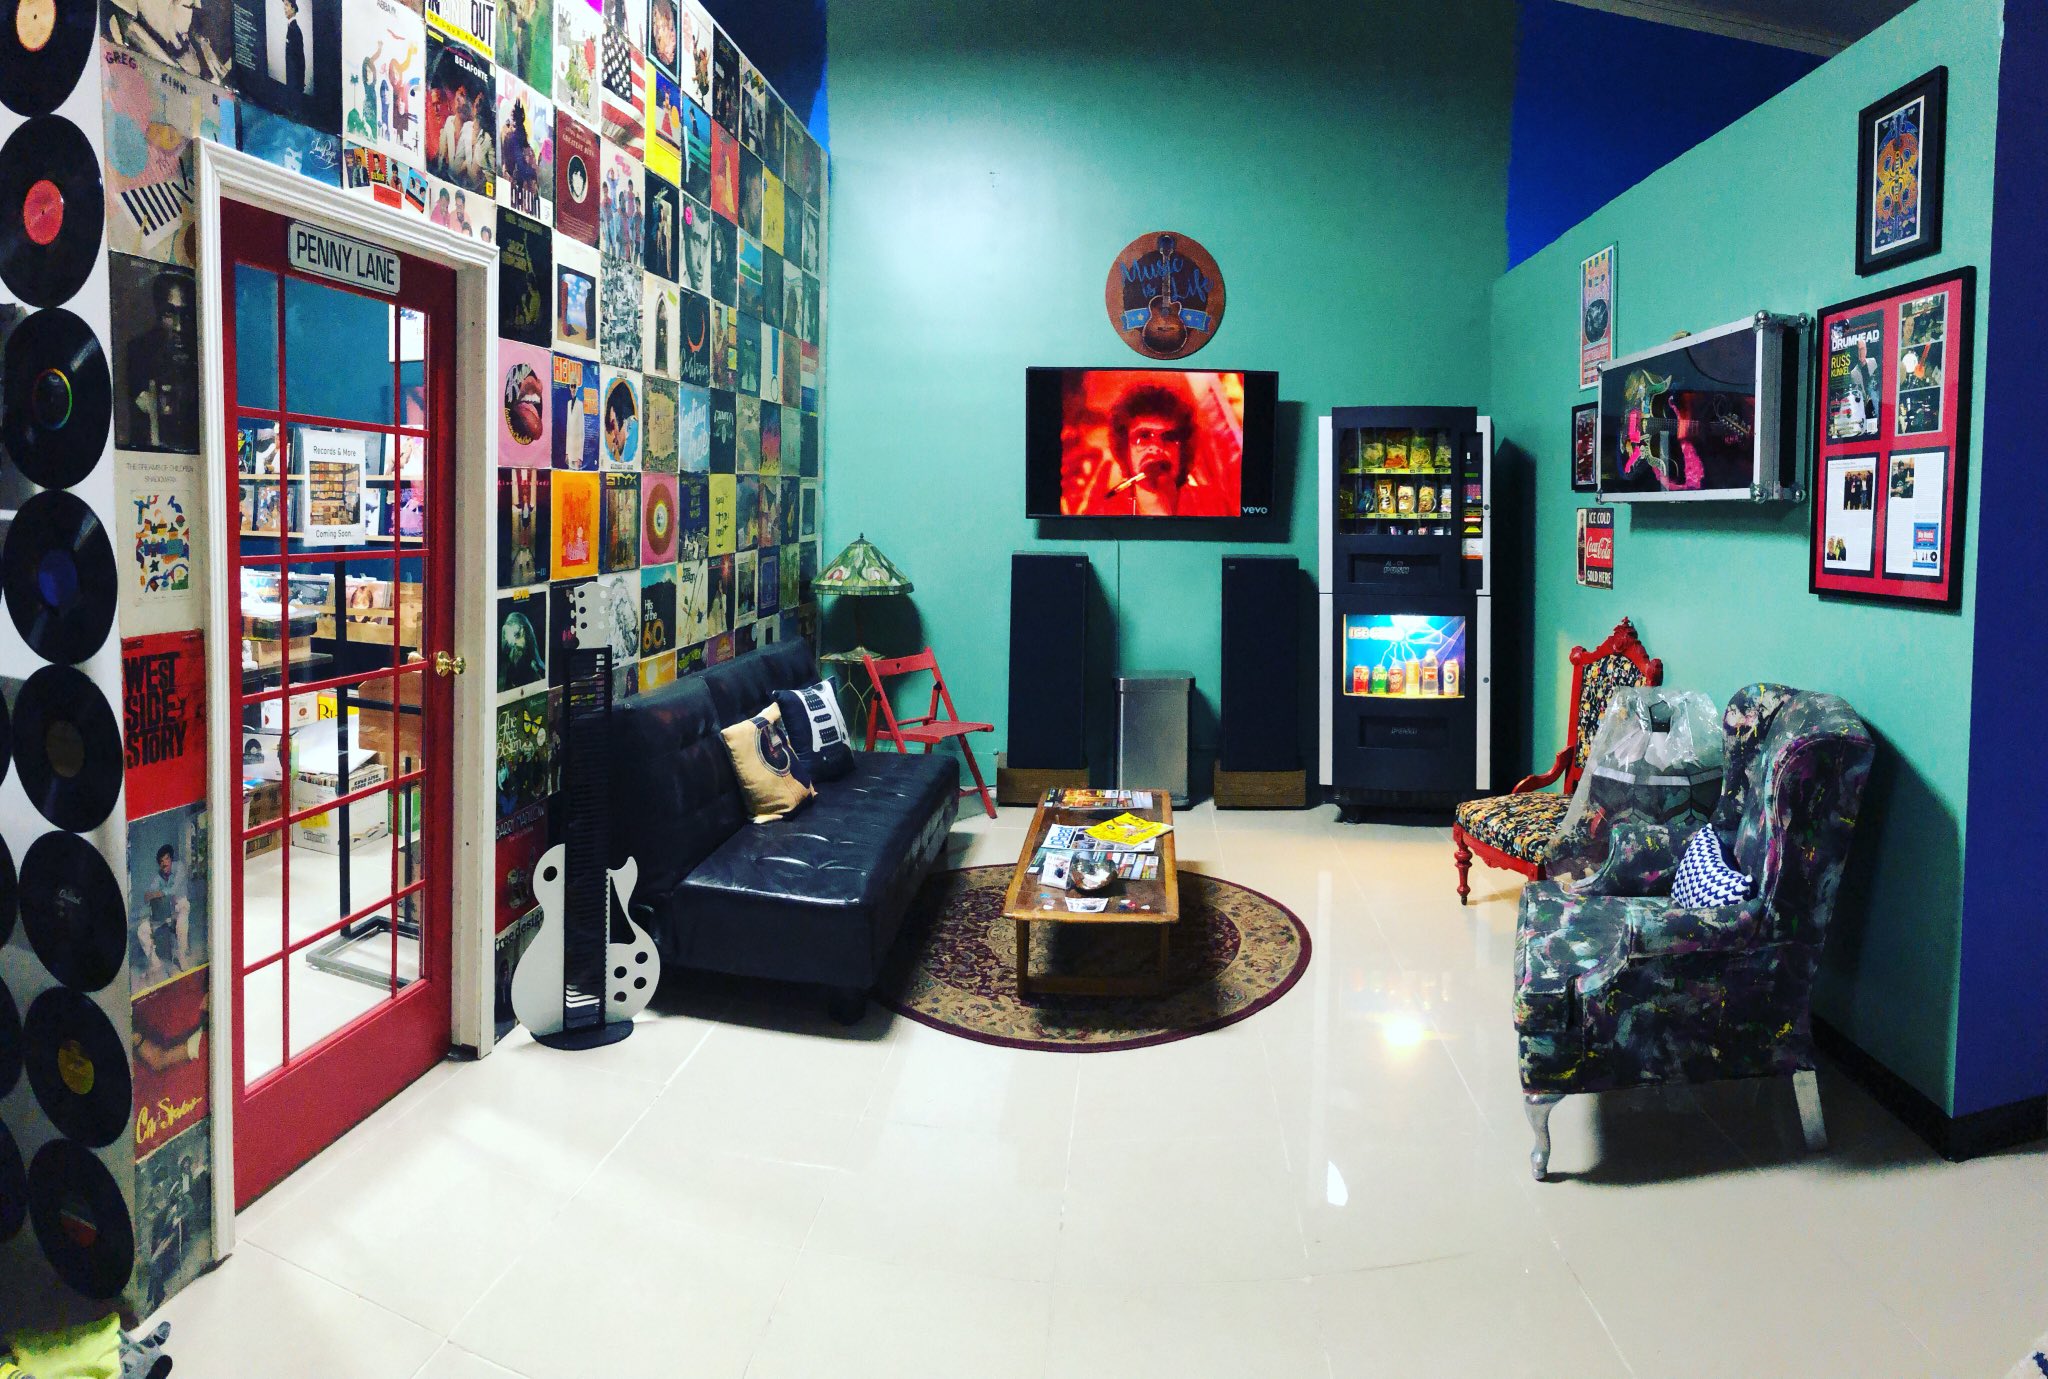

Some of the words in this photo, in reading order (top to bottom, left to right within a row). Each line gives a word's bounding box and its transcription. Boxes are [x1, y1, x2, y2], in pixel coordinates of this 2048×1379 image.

[471, 1, 494, 47] OUT
[105, 51, 137, 70] GREG
[454, 55, 488, 83] BELAFONTE
[296, 230, 353, 273] PENNY
[356, 249, 395, 285] LANE
[1120, 257, 1183, 288] Music
[1171, 267, 1215, 304] Life
[1831, 329, 1880, 352] DRUMHEAD
[1831, 353, 1851, 369] RUSS
[1830, 366, 1851, 378] KUNKEL
[313, 446, 336, 456] Records
[342, 448, 357, 457] More
[606, 472, 637, 486] STYX
[1242, 506, 1268, 514] vevo
[1588, 512, 1597, 524] ICE
[1597, 512, 1611, 525] COLD
[315, 529, 337, 540] Coming
[1587, 570, 1599, 583] SOLD
[1599, 571, 1612, 585] HERE
[644, 599, 654, 611] Hits
[123, 651, 181, 696] WEST
[124, 686, 178, 733] SIDE
[125, 720, 187, 770] STORY
[494, 929, 514, 951] free
